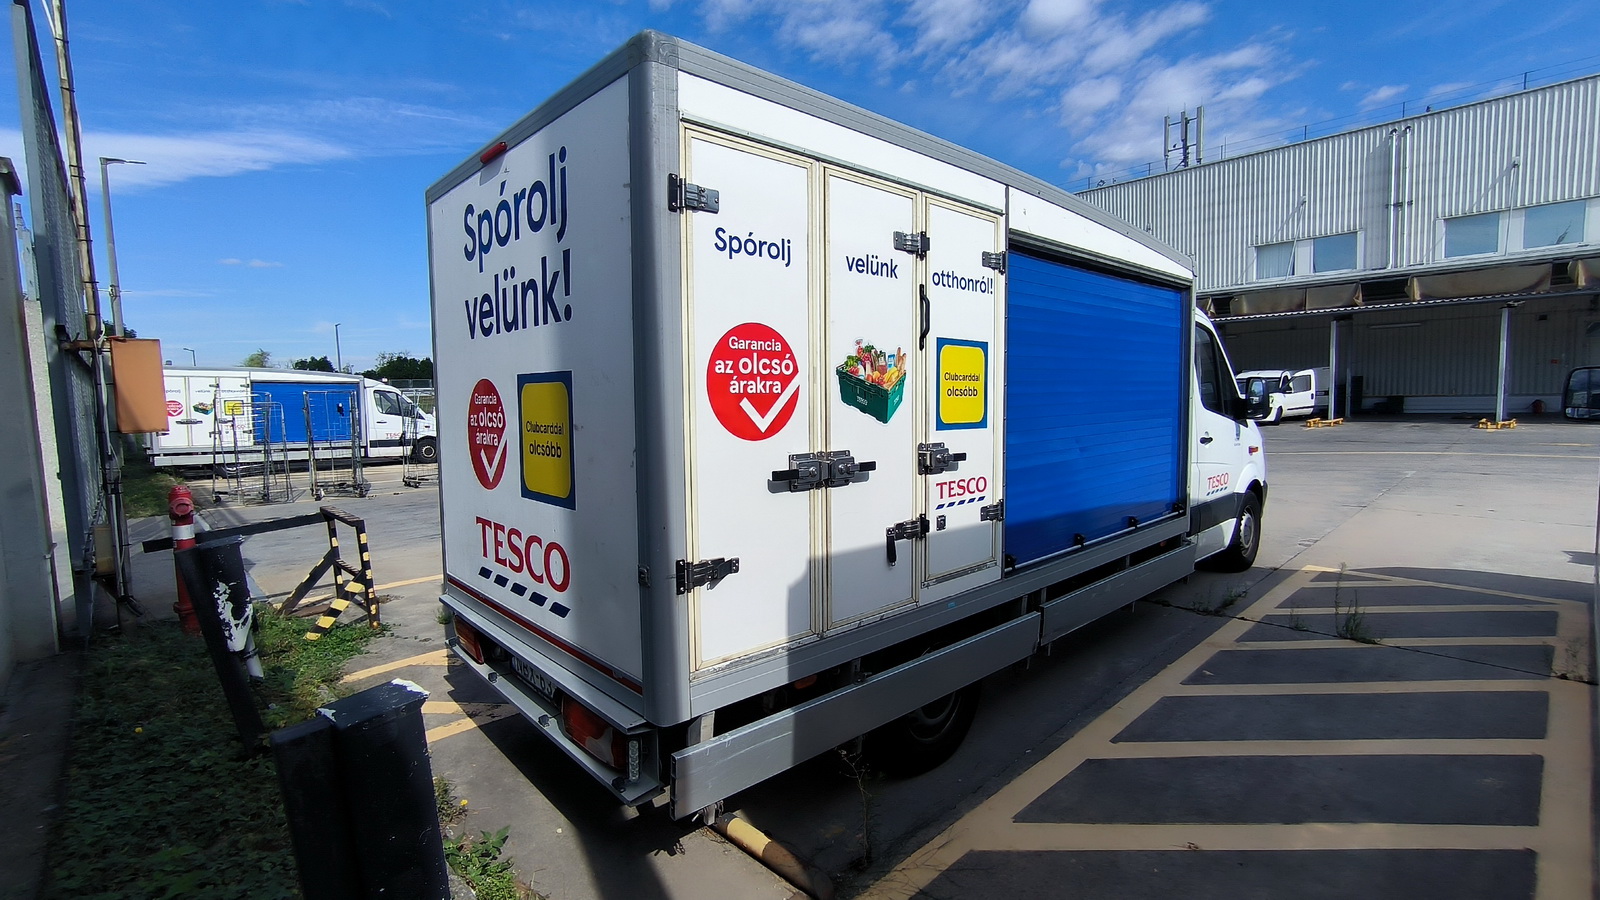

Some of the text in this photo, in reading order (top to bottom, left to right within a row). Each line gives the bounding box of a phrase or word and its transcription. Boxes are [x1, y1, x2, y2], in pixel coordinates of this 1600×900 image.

[463, 145, 568, 273] Spórolj
[714, 226, 994, 294] Spórolj velünk otthonról!
[464, 248, 573, 340] velünk!
[728, 336, 782, 352] Garancia
[715, 352, 794, 374] az olcsó
[729, 375, 782, 394] árakra
[943, 372, 981, 383] Clubcarddal
[474, 392, 497, 406] Garancia
[946, 385, 979, 397] olcsóbb
[469, 407, 504, 428] az olcsó
[475, 429, 499, 447] árakra
[525, 420, 564, 436] Clubcarddal
[528, 438, 562, 459] olcsóbb
[935, 476, 988, 500] TESCO
[1207, 472, 1229, 489] TESCO
[475, 515, 571, 593] TESCO
